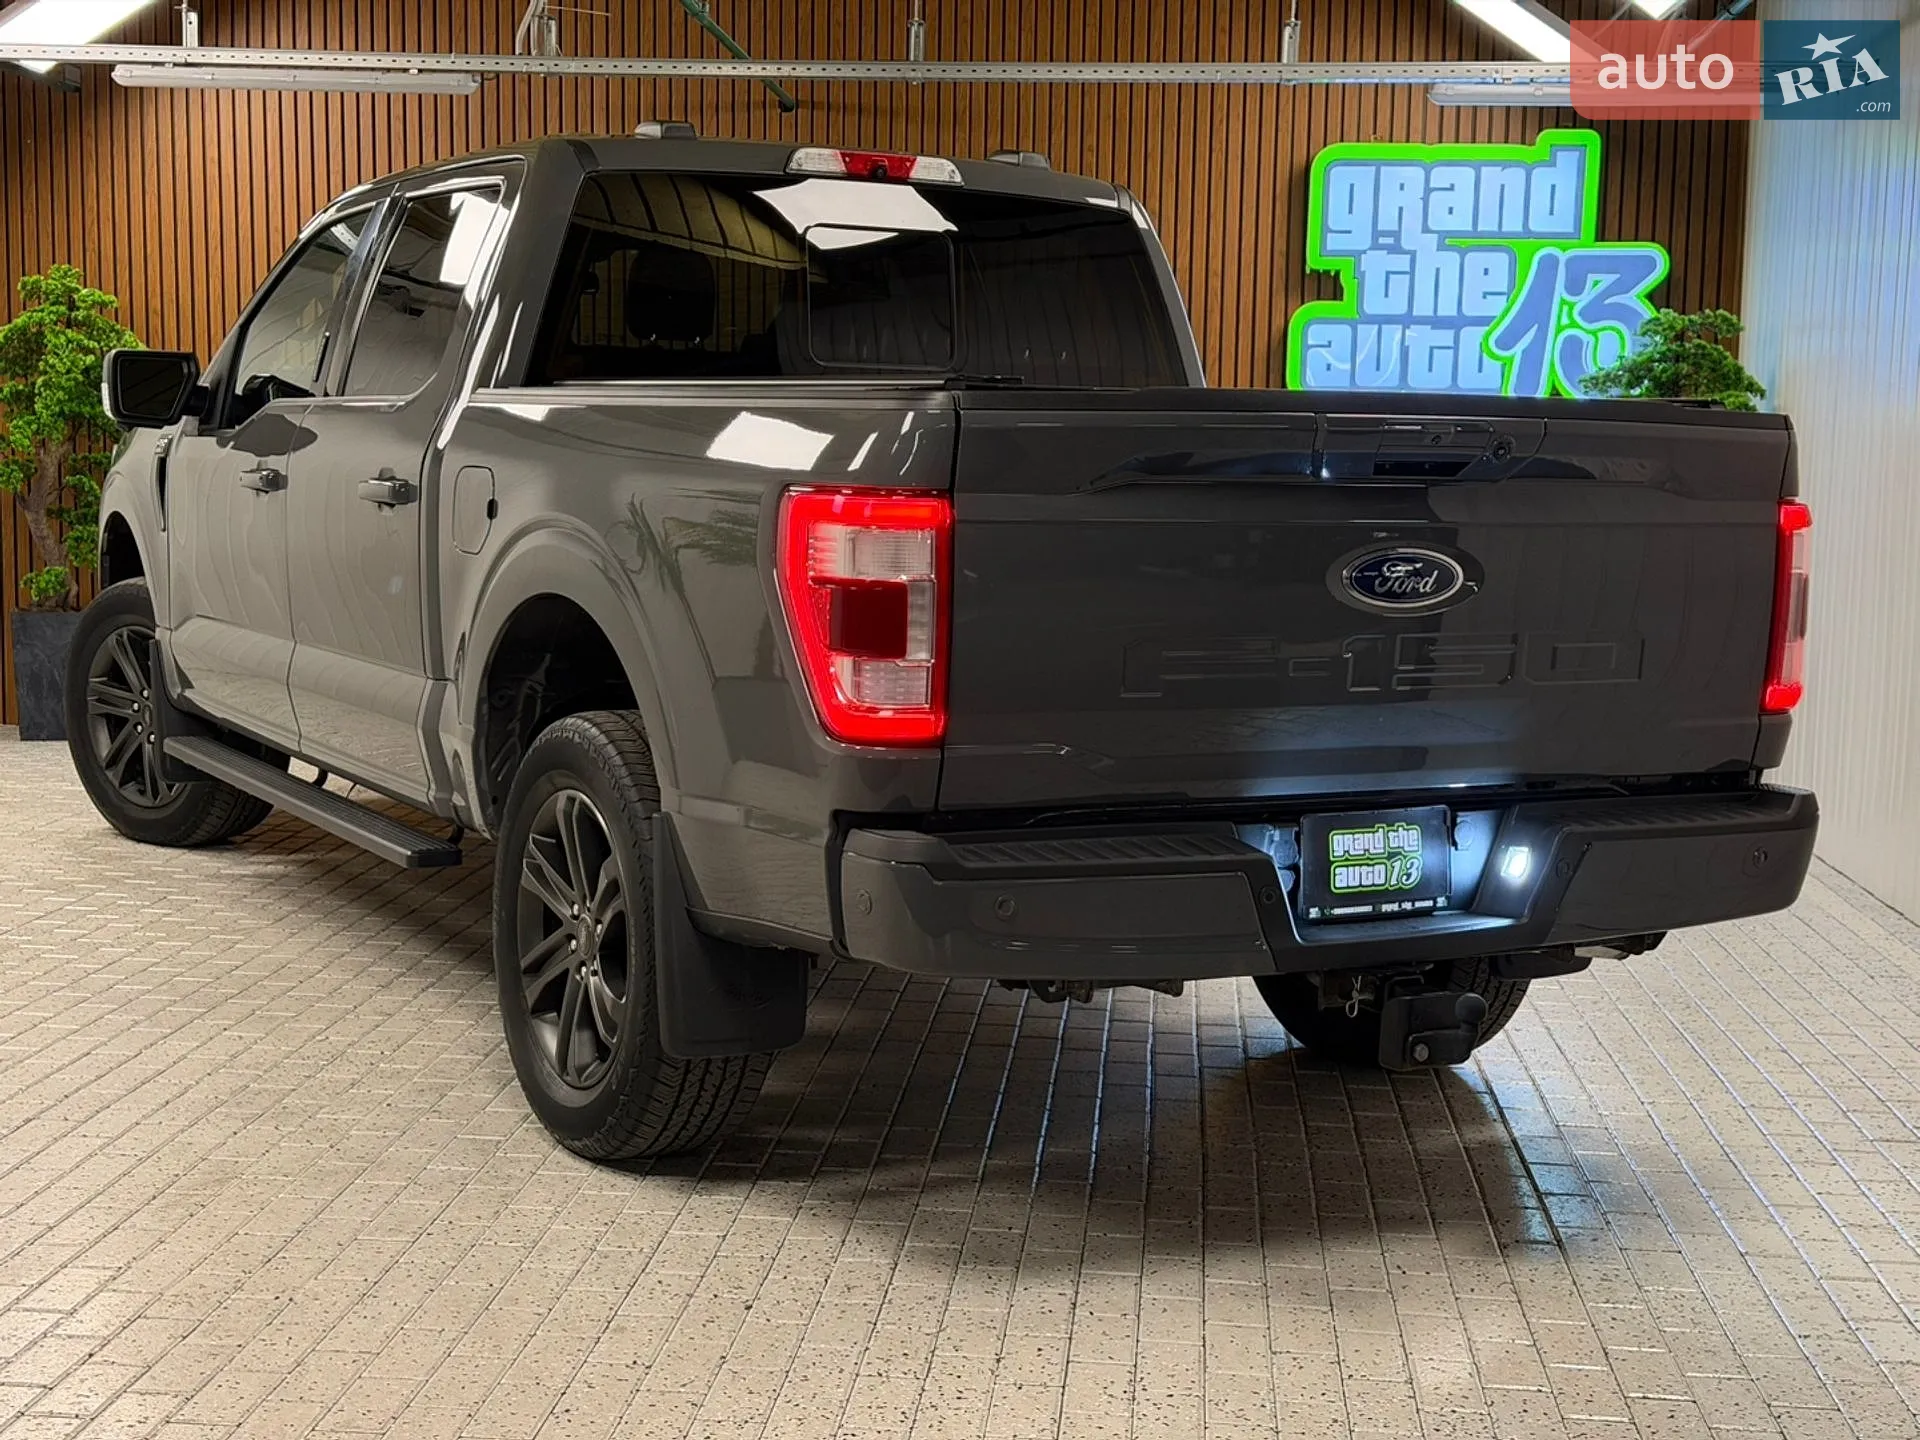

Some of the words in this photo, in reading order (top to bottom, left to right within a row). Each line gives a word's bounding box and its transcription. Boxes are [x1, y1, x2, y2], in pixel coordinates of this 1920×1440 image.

[1360, 233, 1510, 317] the
[1305, 323, 1504, 391] auto
[1487, 246, 1660, 398] 13
[1374, 560, 1439, 594] Ford
[1120, 632, 1646, 697] F-150
[1333, 828, 1385, 857] grand
[1388, 827, 1419, 852] the
[1334, 863, 1386, 888] auto
[1390, 858, 1421, 886] 13
